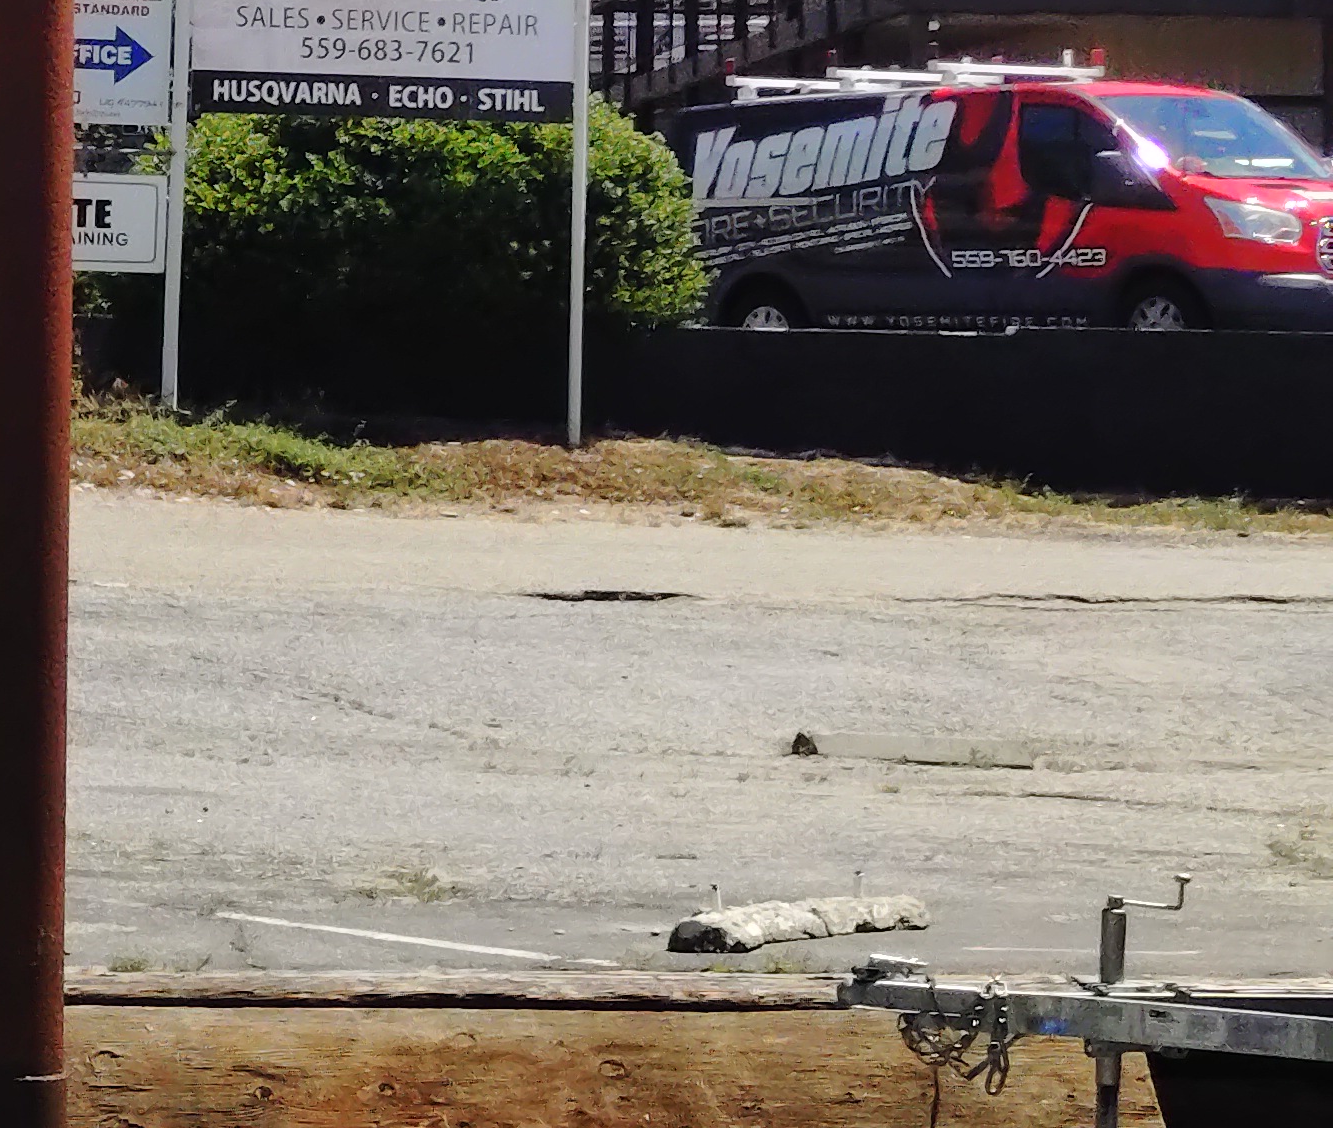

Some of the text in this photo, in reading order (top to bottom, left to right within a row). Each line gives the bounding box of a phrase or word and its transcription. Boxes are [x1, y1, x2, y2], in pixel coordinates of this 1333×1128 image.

[74, 3, 150, 17] STANDARD
[235, 5, 538, 36] SALES SERVICE REPAIR
[300, 36, 475, 64] 559-683-7621
[213, 78, 545, 113] HUSQVARNA ECHO STIHL
[692, 94, 958, 199] Yosemite
[768, 176, 936, 231] SECURITY
[951, 248, 1107, 268] 559-760-4423
